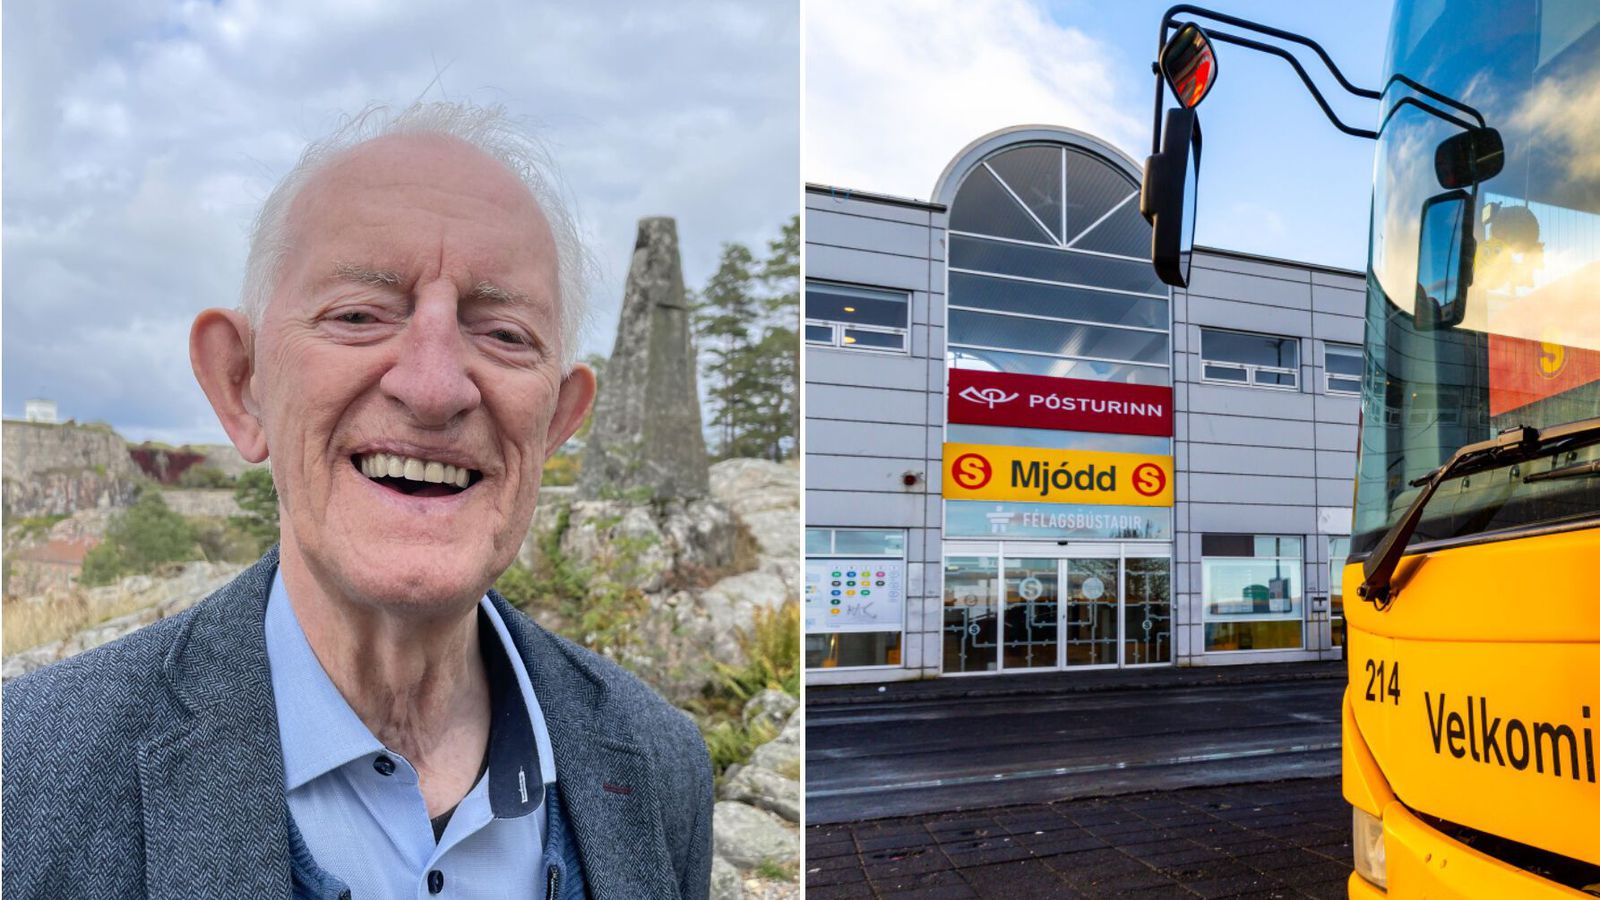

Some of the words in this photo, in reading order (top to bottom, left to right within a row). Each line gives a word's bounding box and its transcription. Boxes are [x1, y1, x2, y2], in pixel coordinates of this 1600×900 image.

[1029, 393, 1163, 417] PÓSTURINN
[958, 455, 987, 488] S
[1011, 459, 1117, 496] Mjódd
[1136, 465, 1162, 495] S
[1365, 659, 1401, 705] 214
[1424, 692, 1597, 783] Velkomi
